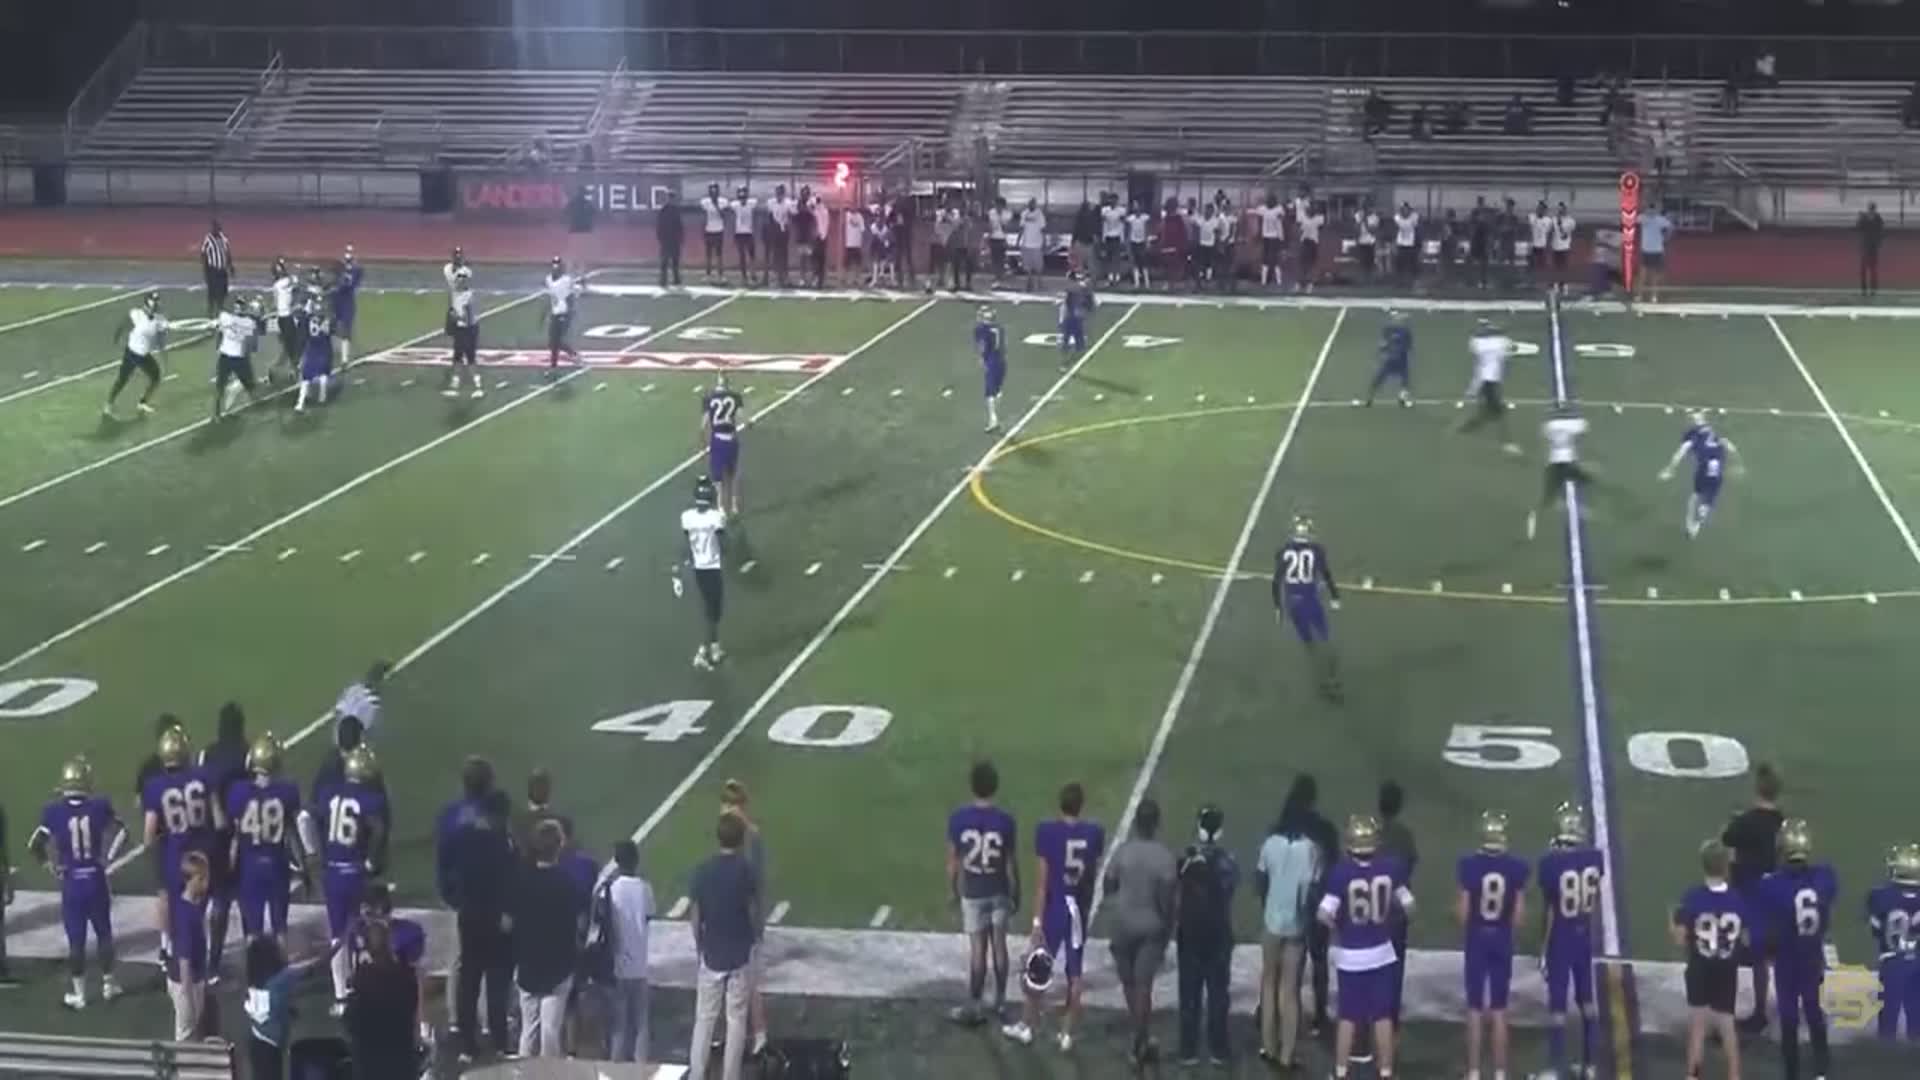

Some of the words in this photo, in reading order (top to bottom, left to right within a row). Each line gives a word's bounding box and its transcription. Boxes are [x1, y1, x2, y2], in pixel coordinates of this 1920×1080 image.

[584, 183, 670, 211] FIELD
[710, 397, 736, 425] 22
[1283, 550, 1314, 584] 20
[161, 780, 205, 833] 66
[240, 798, 284, 845] 48
[329, 795, 360, 846] 16
[68, 815, 92, 860] 11
[1063, 840, 1087, 885] 5
[1348, 875, 1392, 924] 60
[1480, 872, 1505, 920] 8
[1795, 888, 1820, 936] 6
[1695, 913, 1741, 958] 93
